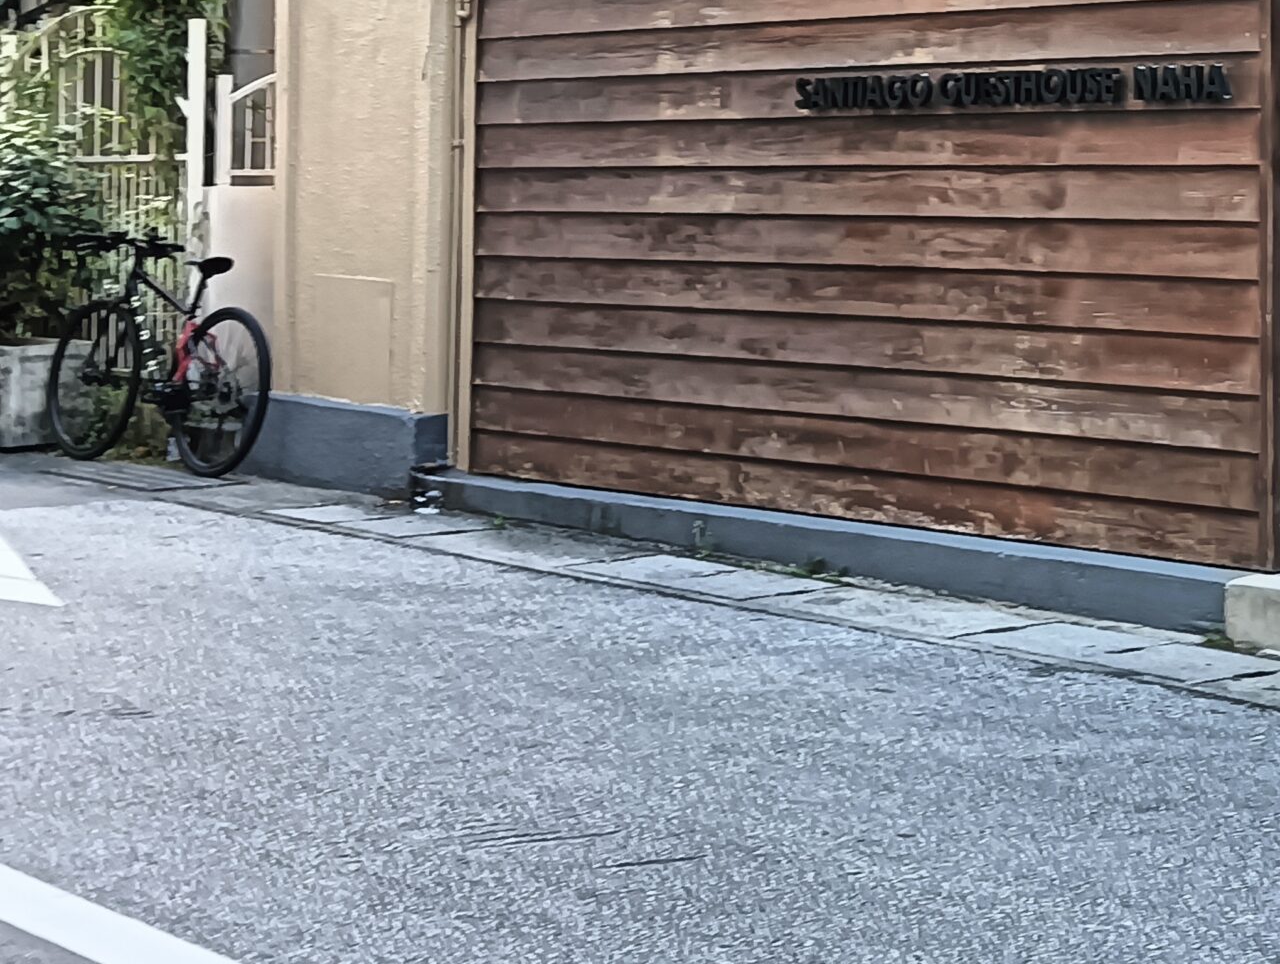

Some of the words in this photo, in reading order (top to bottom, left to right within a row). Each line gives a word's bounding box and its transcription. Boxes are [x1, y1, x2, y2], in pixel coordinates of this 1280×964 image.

[795, 73, 933, 109] SANTIAGO
[938, 68, 1123, 107] GUESTHOUSE
[1133, 63, 1232, 101] NAHA
